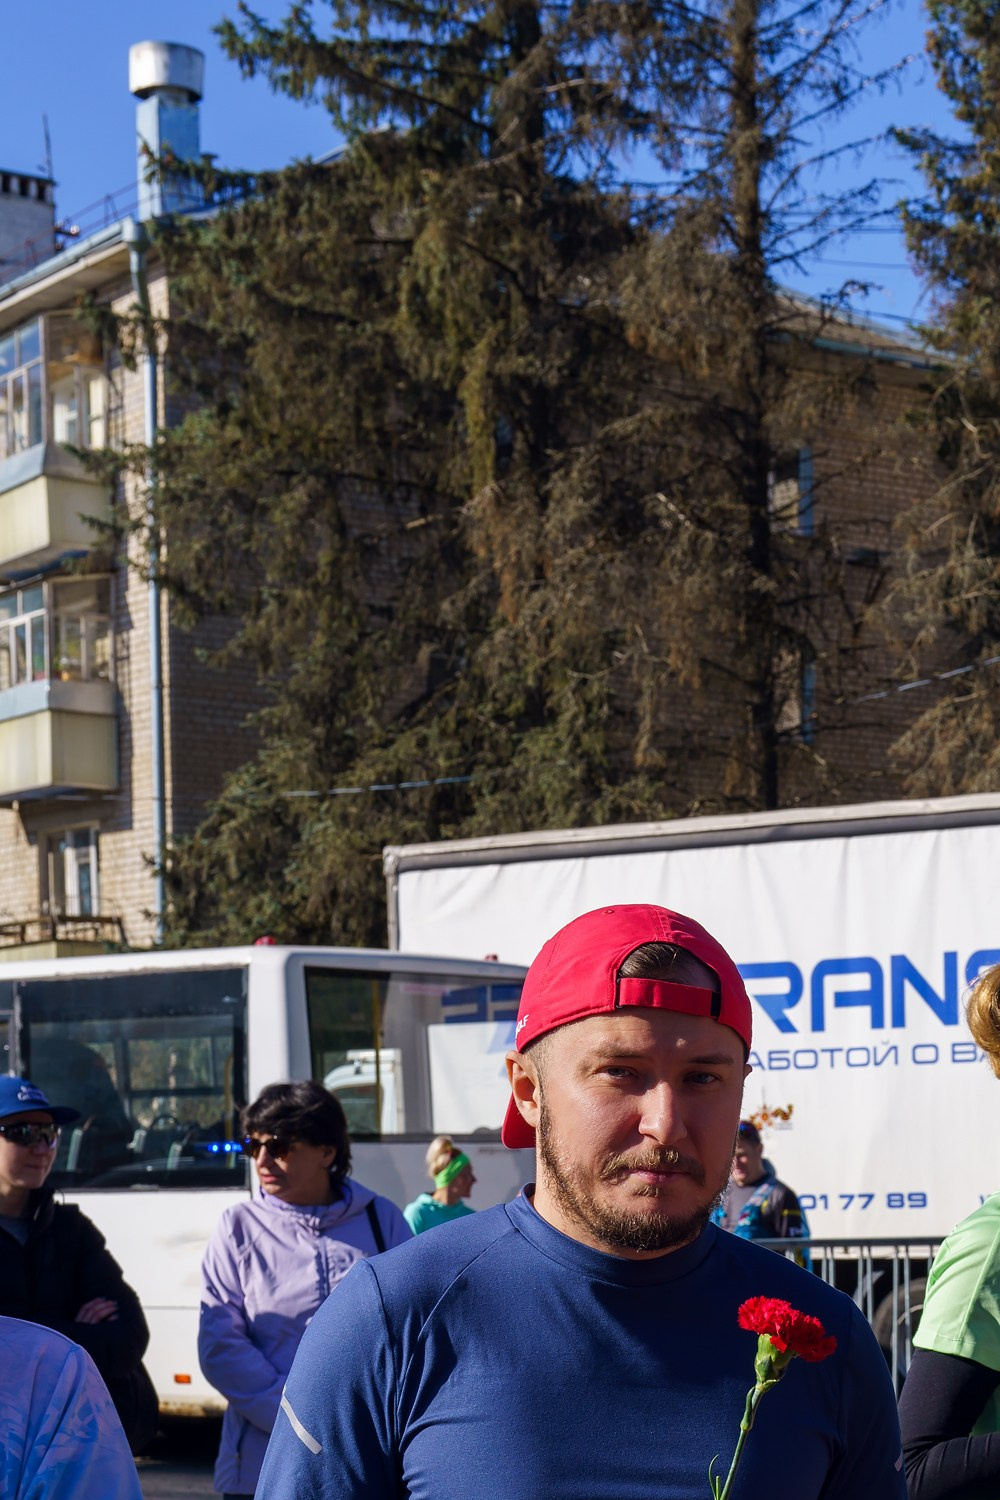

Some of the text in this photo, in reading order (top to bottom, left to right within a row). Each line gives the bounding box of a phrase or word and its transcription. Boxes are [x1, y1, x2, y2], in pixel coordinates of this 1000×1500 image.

[912, 1043, 939, 1065] О
[839, 1193, 876, 1210] 77
[886, 1192, 928, 1208] 89
